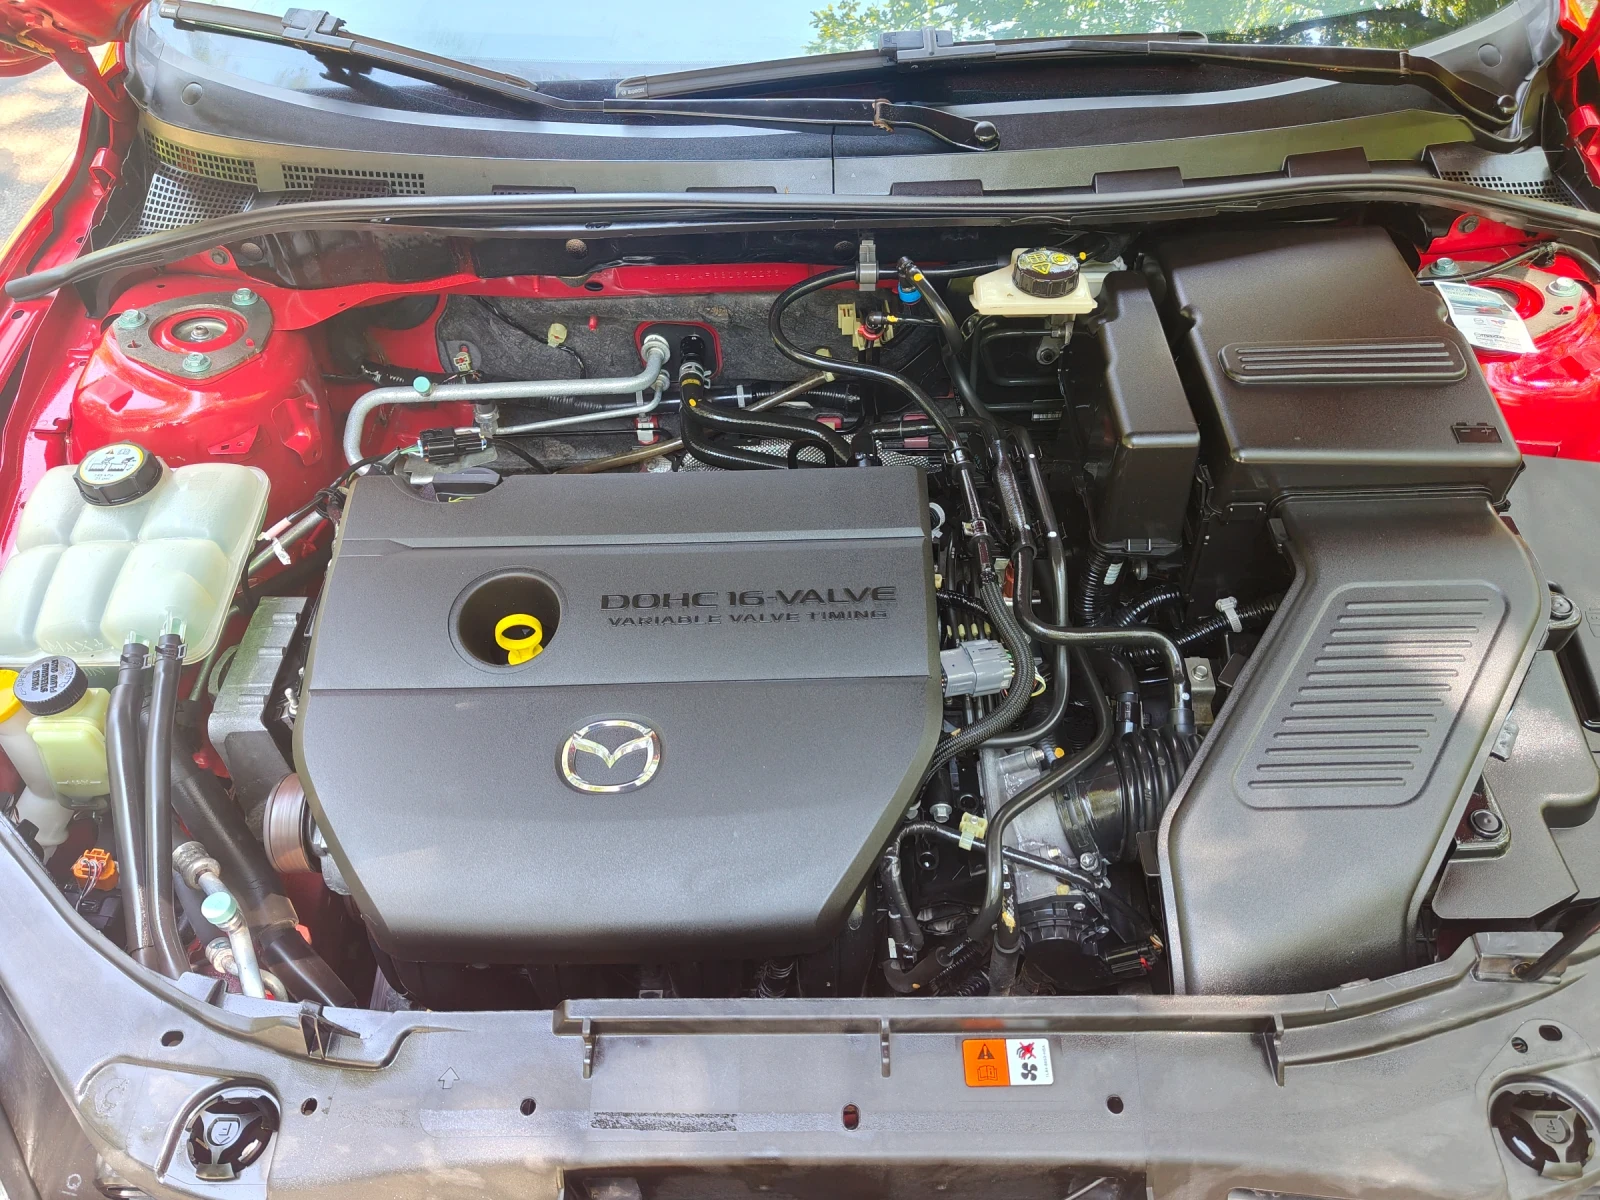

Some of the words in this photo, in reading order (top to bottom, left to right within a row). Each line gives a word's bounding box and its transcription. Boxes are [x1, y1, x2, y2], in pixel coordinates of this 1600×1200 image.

[600, 591, 718, 612] DOHC
[726, 586, 897, 609] 16-VALVE
[607, 613, 722, 627] VARIABLE
[730, 611, 799, 624] VALVE
[806, 608, 888, 622] TIMING
[40, 662, 50, 693] STEERING
